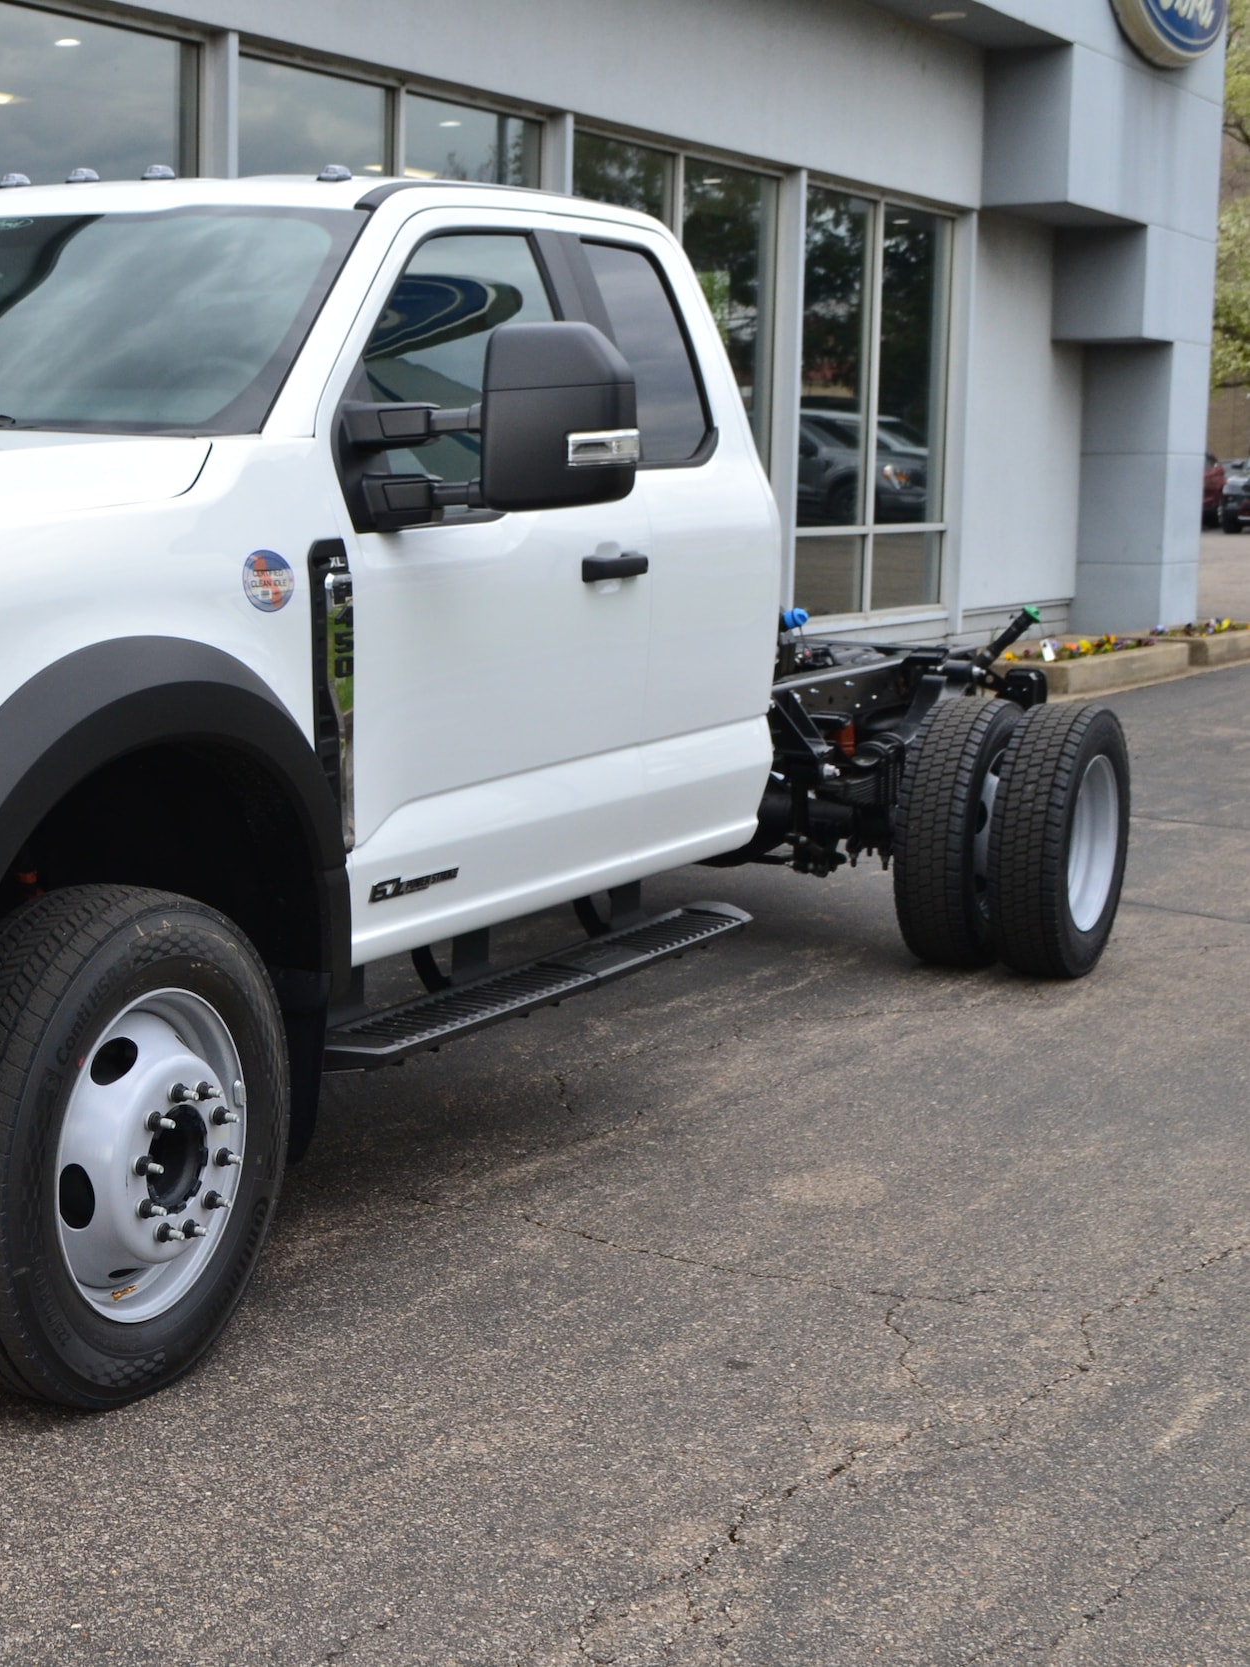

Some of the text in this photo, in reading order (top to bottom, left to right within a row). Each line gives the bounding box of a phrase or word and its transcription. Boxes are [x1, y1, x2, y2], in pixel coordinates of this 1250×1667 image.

[1159, 0, 1215, 29] ord
[329, 556, 345, 568] XL
[252, 569, 284, 577] CERTIFIED
[251, 579, 287, 588] CLEAN IDLE
